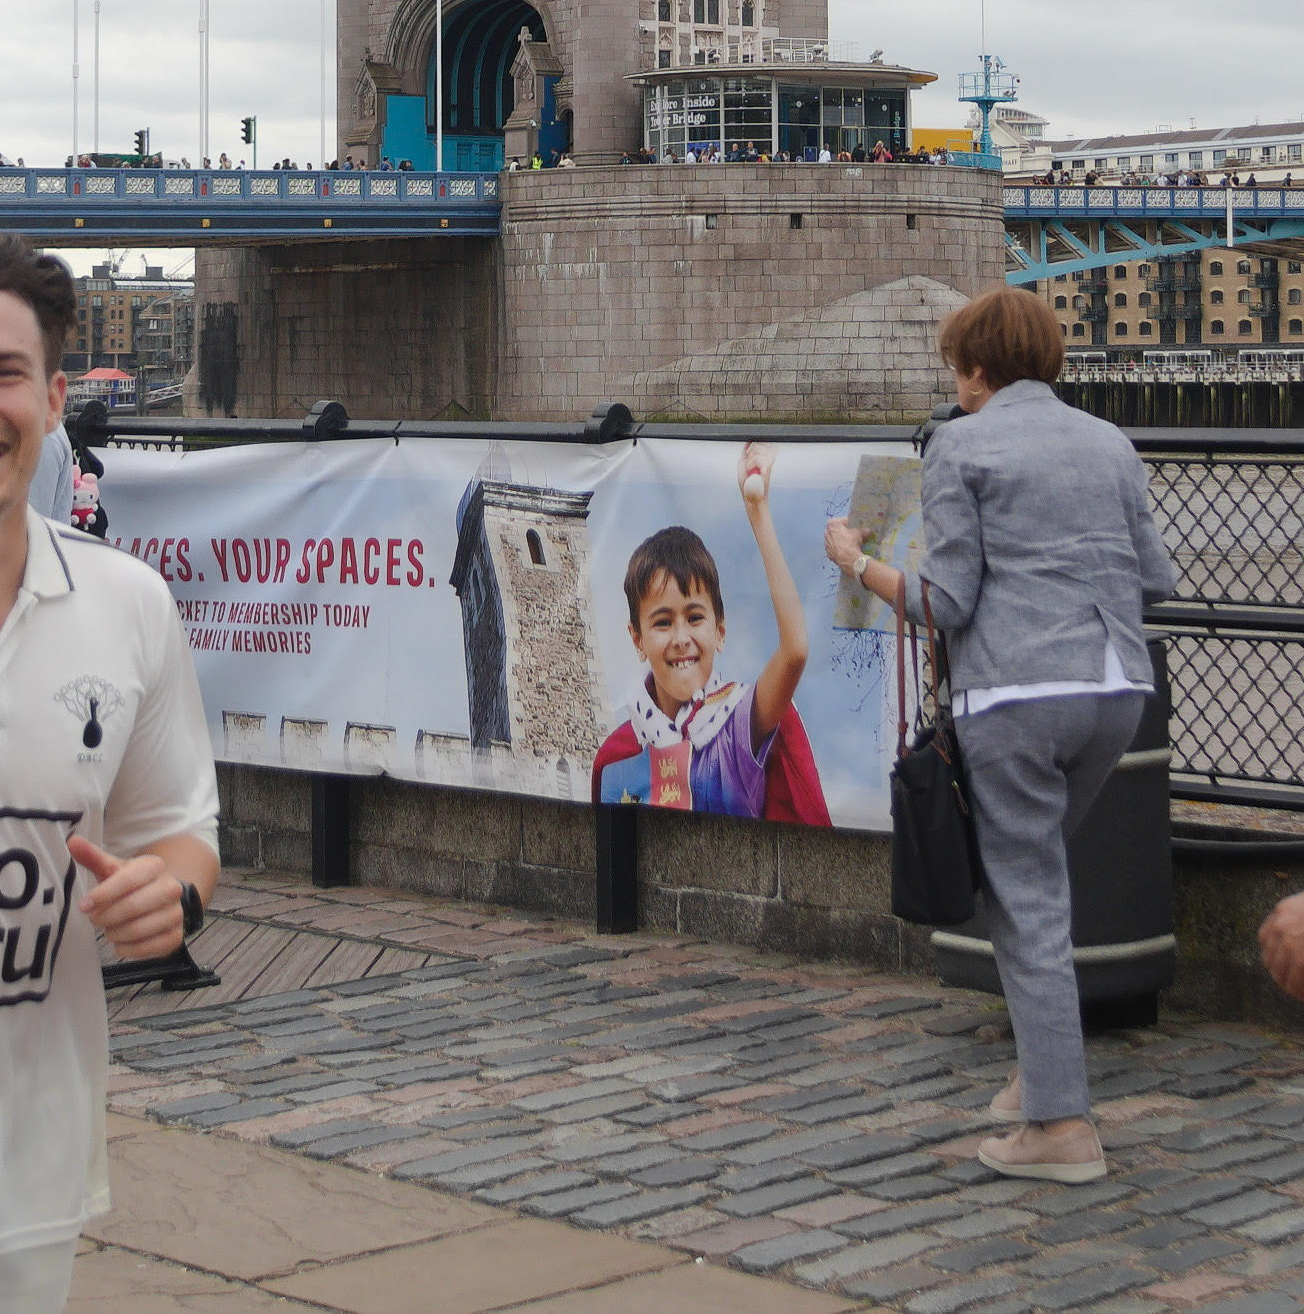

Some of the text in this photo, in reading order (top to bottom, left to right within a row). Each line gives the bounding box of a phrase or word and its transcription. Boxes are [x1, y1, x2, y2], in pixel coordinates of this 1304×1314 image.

[210, 538, 291, 584] YOUR
[295, 537, 435, 588] SPACES.
[212, 601, 227, 623] TO
[227, 602, 318, 626] MEMBERSHIP
[323, 604, 371, 628] TODAY
[189, 628, 311, 655] FAMILY MEMORIES
